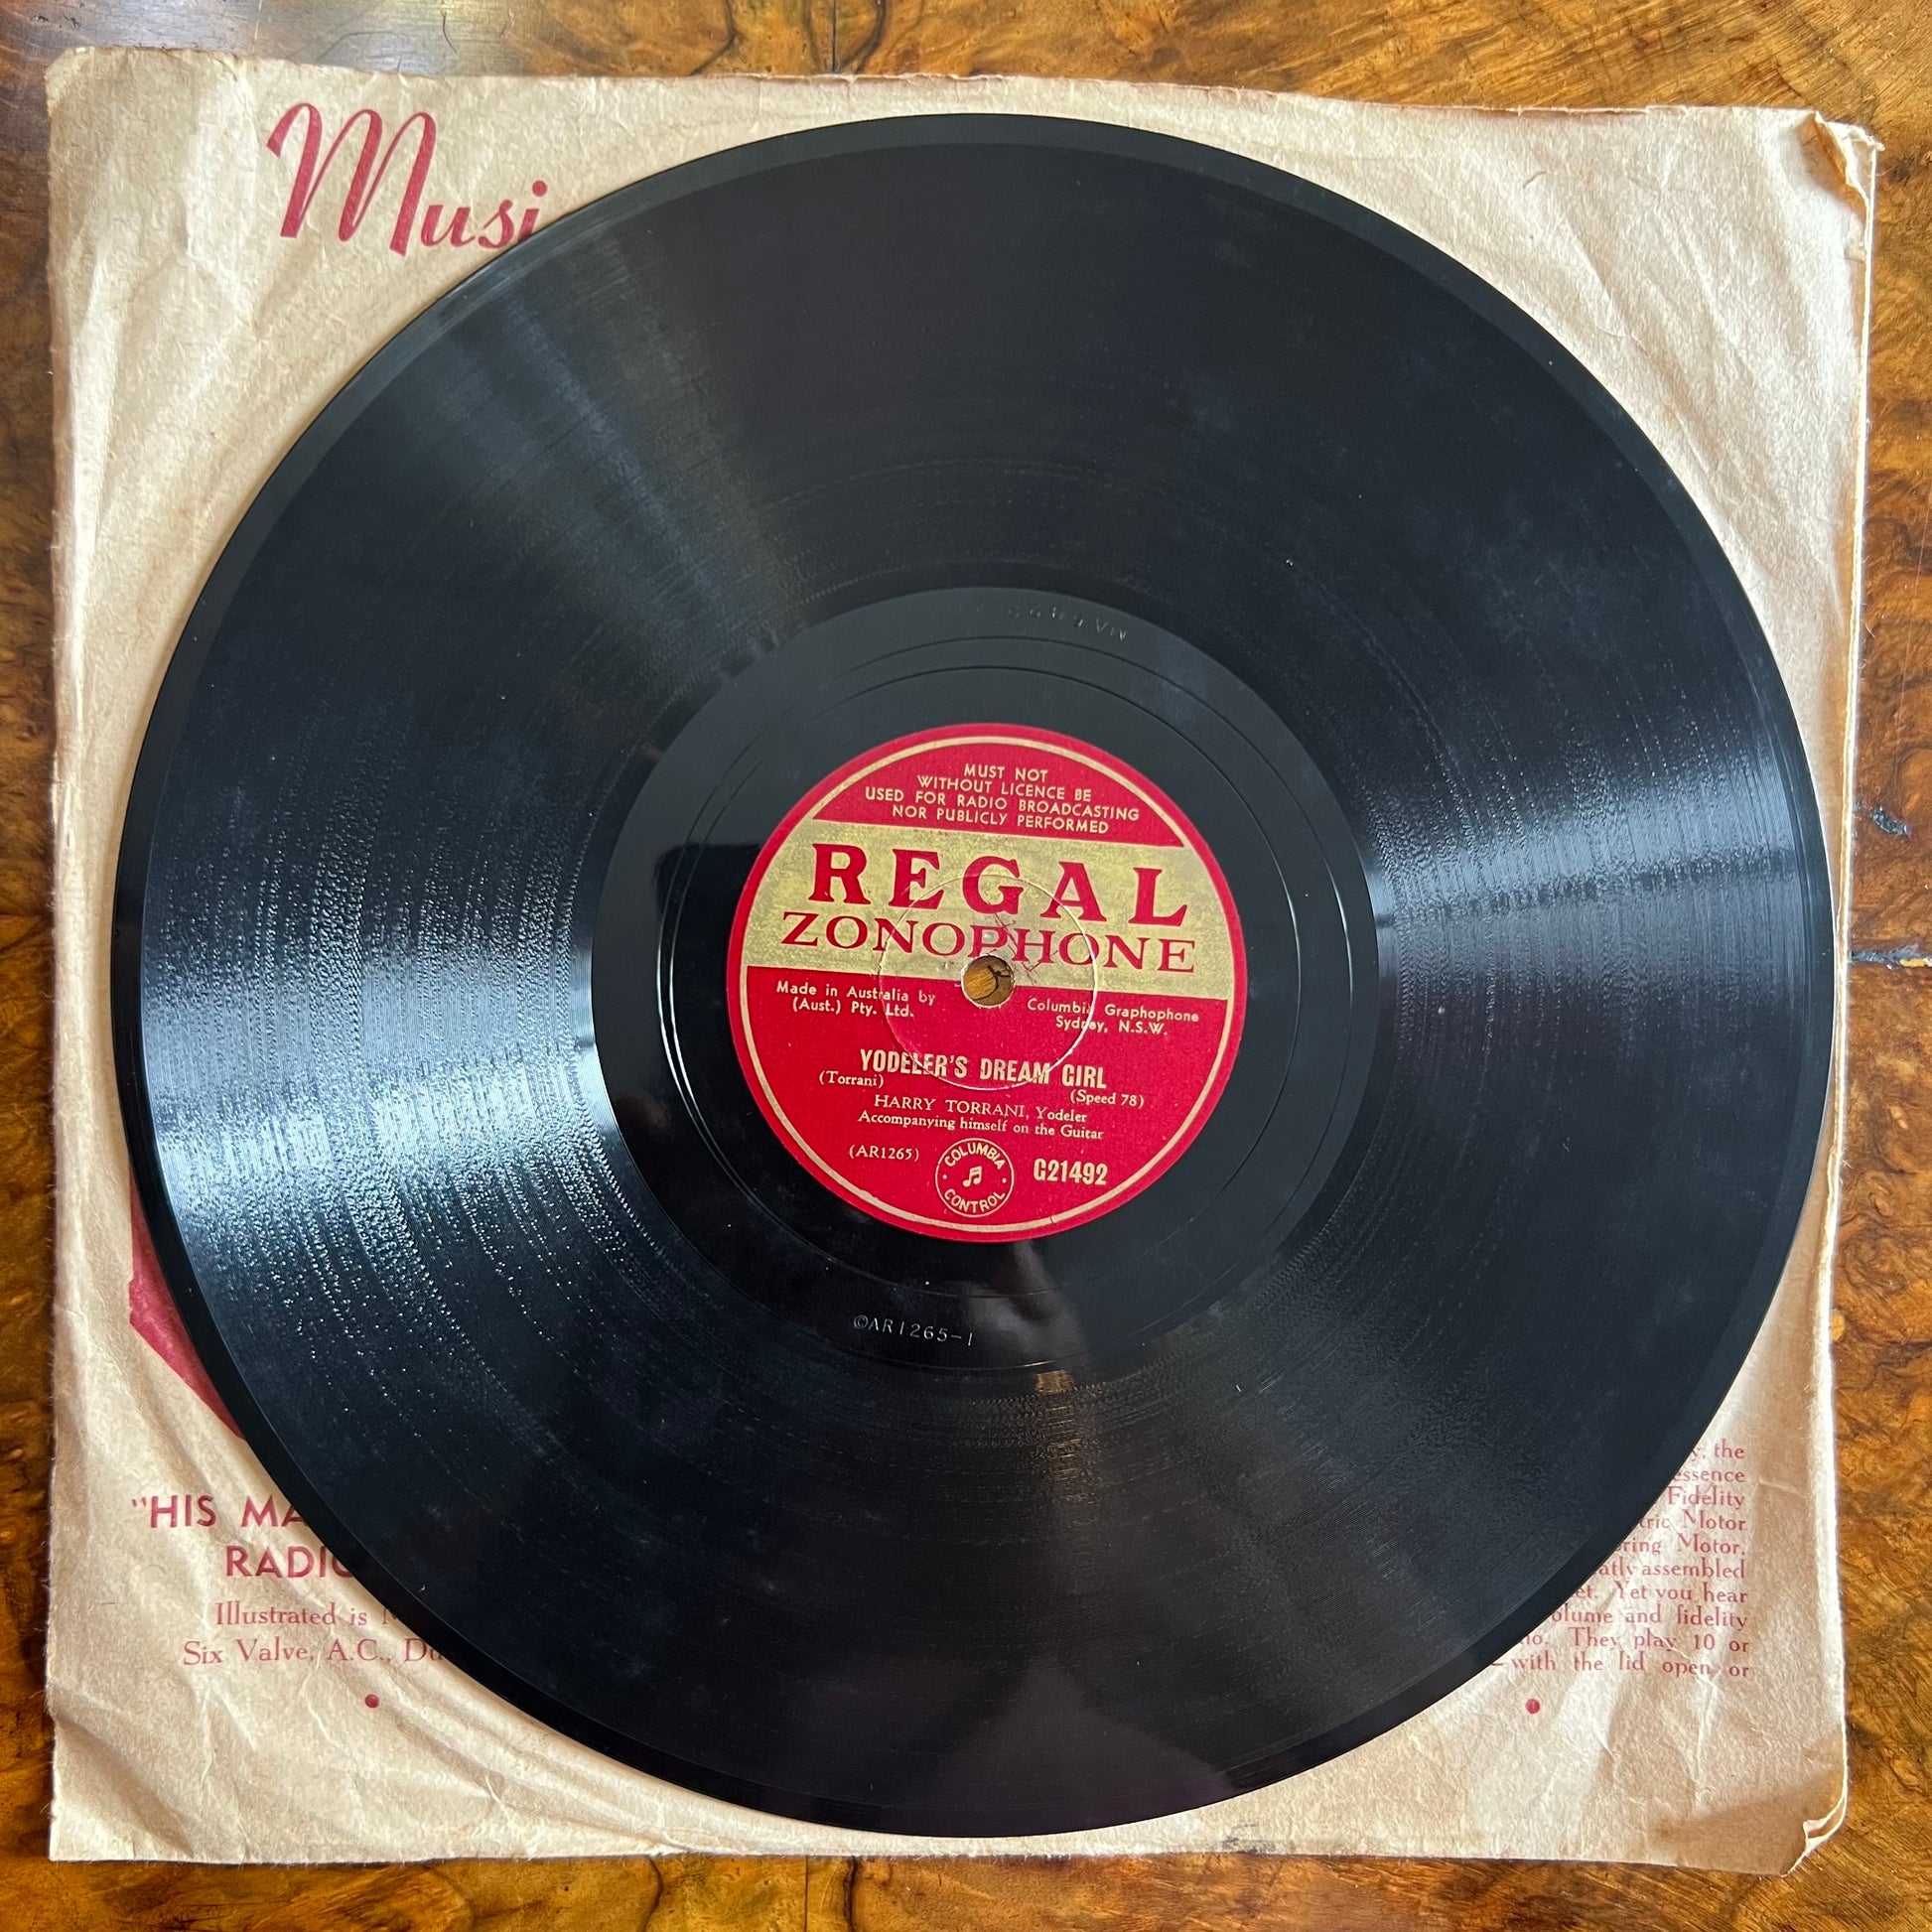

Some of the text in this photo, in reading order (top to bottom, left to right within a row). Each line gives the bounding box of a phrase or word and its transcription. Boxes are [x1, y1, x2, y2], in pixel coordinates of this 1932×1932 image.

[265, 102, 547, 257] Musi
[964, 763, 1048, 782] MUST NOT
[917, 775, 1091, 801] WITHOUT LICENCE BE
[865, 787, 1140, 821] USED FOR RADIO BROADCASTING
[893, 805, 1109, 834] NOR PUBLICLY PERFORMED
[807, 842, 1188, 927] REGAL
[780, 910, 1195, 974] ZONOPHONE
[776, 981, 936, 1006] Made in Australia by
[792, 997, 914, 1018] (Aust.) Pty. Ltd.
[1028, 998, 1199, 1023] Columbia Graphophone
[1055, 1016, 1168, 1035] Sydney, N.S.W.
[819, 1070, 885, 1088] (Torrani)
[860, 1048, 1107, 1089] YODELER'S DREAM GIRL
[874, 1094, 1088, 1123] HARRY TORRANI, Yodeler
[1070, 1090, 1144, 1108] (Speed 78)
[858, 1110, 1104, 1140] Accompanying himself on the Guitar
[848, 1145, 919, 1162] (AR1265)
[944, 1142, 1006, 1171] COLUMBIA
[943, 1188, 1006, 1213] CONTROL
[1715, 1439, 1744, 1459] the
[1673, 1470, 1745, 1482] essence
[1667, 1485, 1744, 1510] Fidelity
[1682, 1508, 1746, 1530] Motor
[1677, 1533, 1745, 1555] Motor.
[1595, 1557, 1745, 1579] atly assembled
[1572, 1581, 1747, 1603] et. Yet you hear
[215, 1600, 336, 1625] Illustrated
[349, 1608, 367, 1625] is
[1552, 1602, 1747, 1631] olume and fidelity
[183, 1640, 223, 1666] Six
[235, 1636, 315, 1662] Valve,
[1568, 1627, 1620, 1650] They
[1634, 1628, 1677, 1652] play
[1694, 1634, 1715, 1650] 10
[1728, 1640, 1749, 1653] or
[1574, 1651, 1603, 1671] the
[1618, 1651, 1645, 1670] lid
[1662, 1660, 1711, 1677] open
[1728, 1665, 1749, 1678] or
